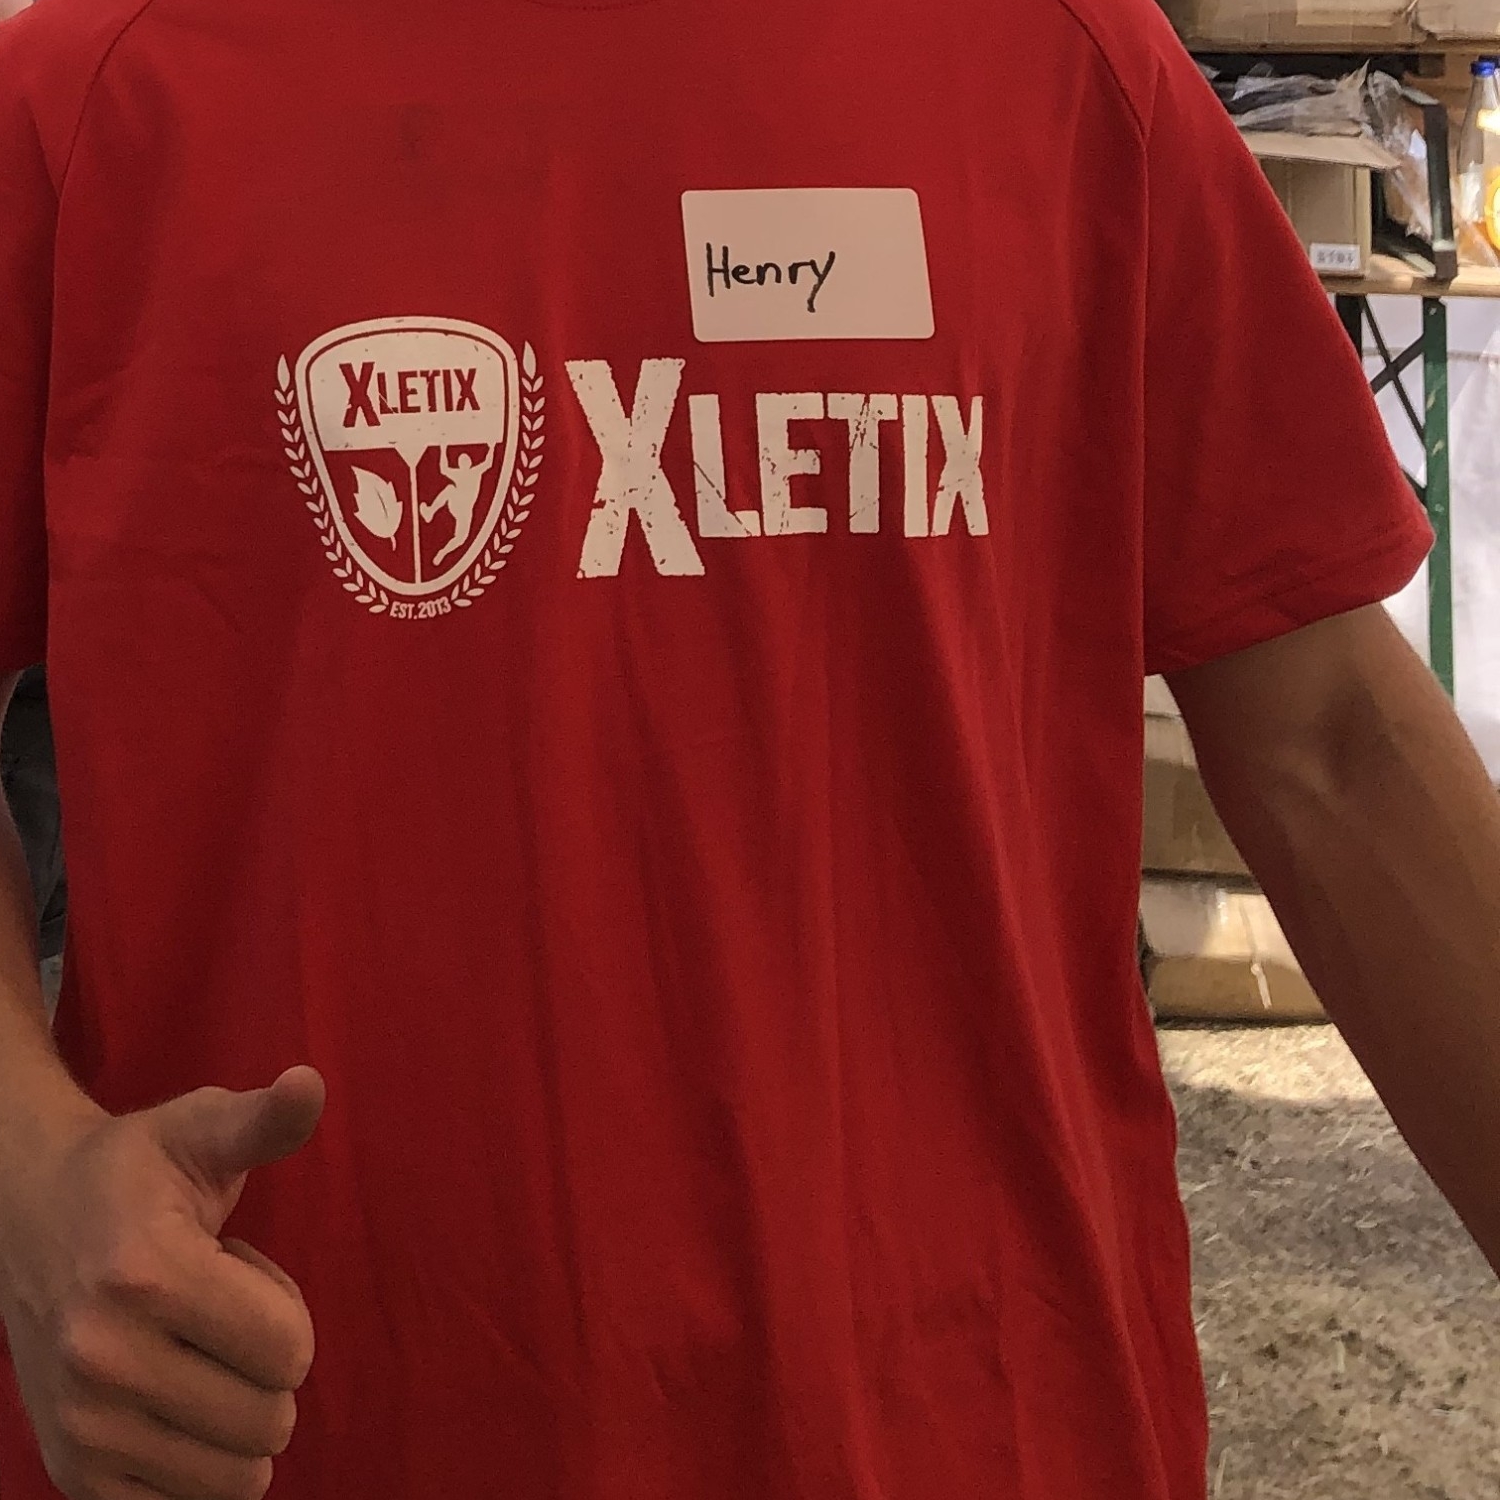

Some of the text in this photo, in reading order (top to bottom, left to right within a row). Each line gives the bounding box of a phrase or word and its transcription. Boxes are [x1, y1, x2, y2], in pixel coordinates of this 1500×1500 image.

[706, 243, 836, 313] Henry
[339, 361, 481, 428] XLETIX
[564, 357, 989, 580] XLETIX
[389, 596, 452, 620] EST.2013
